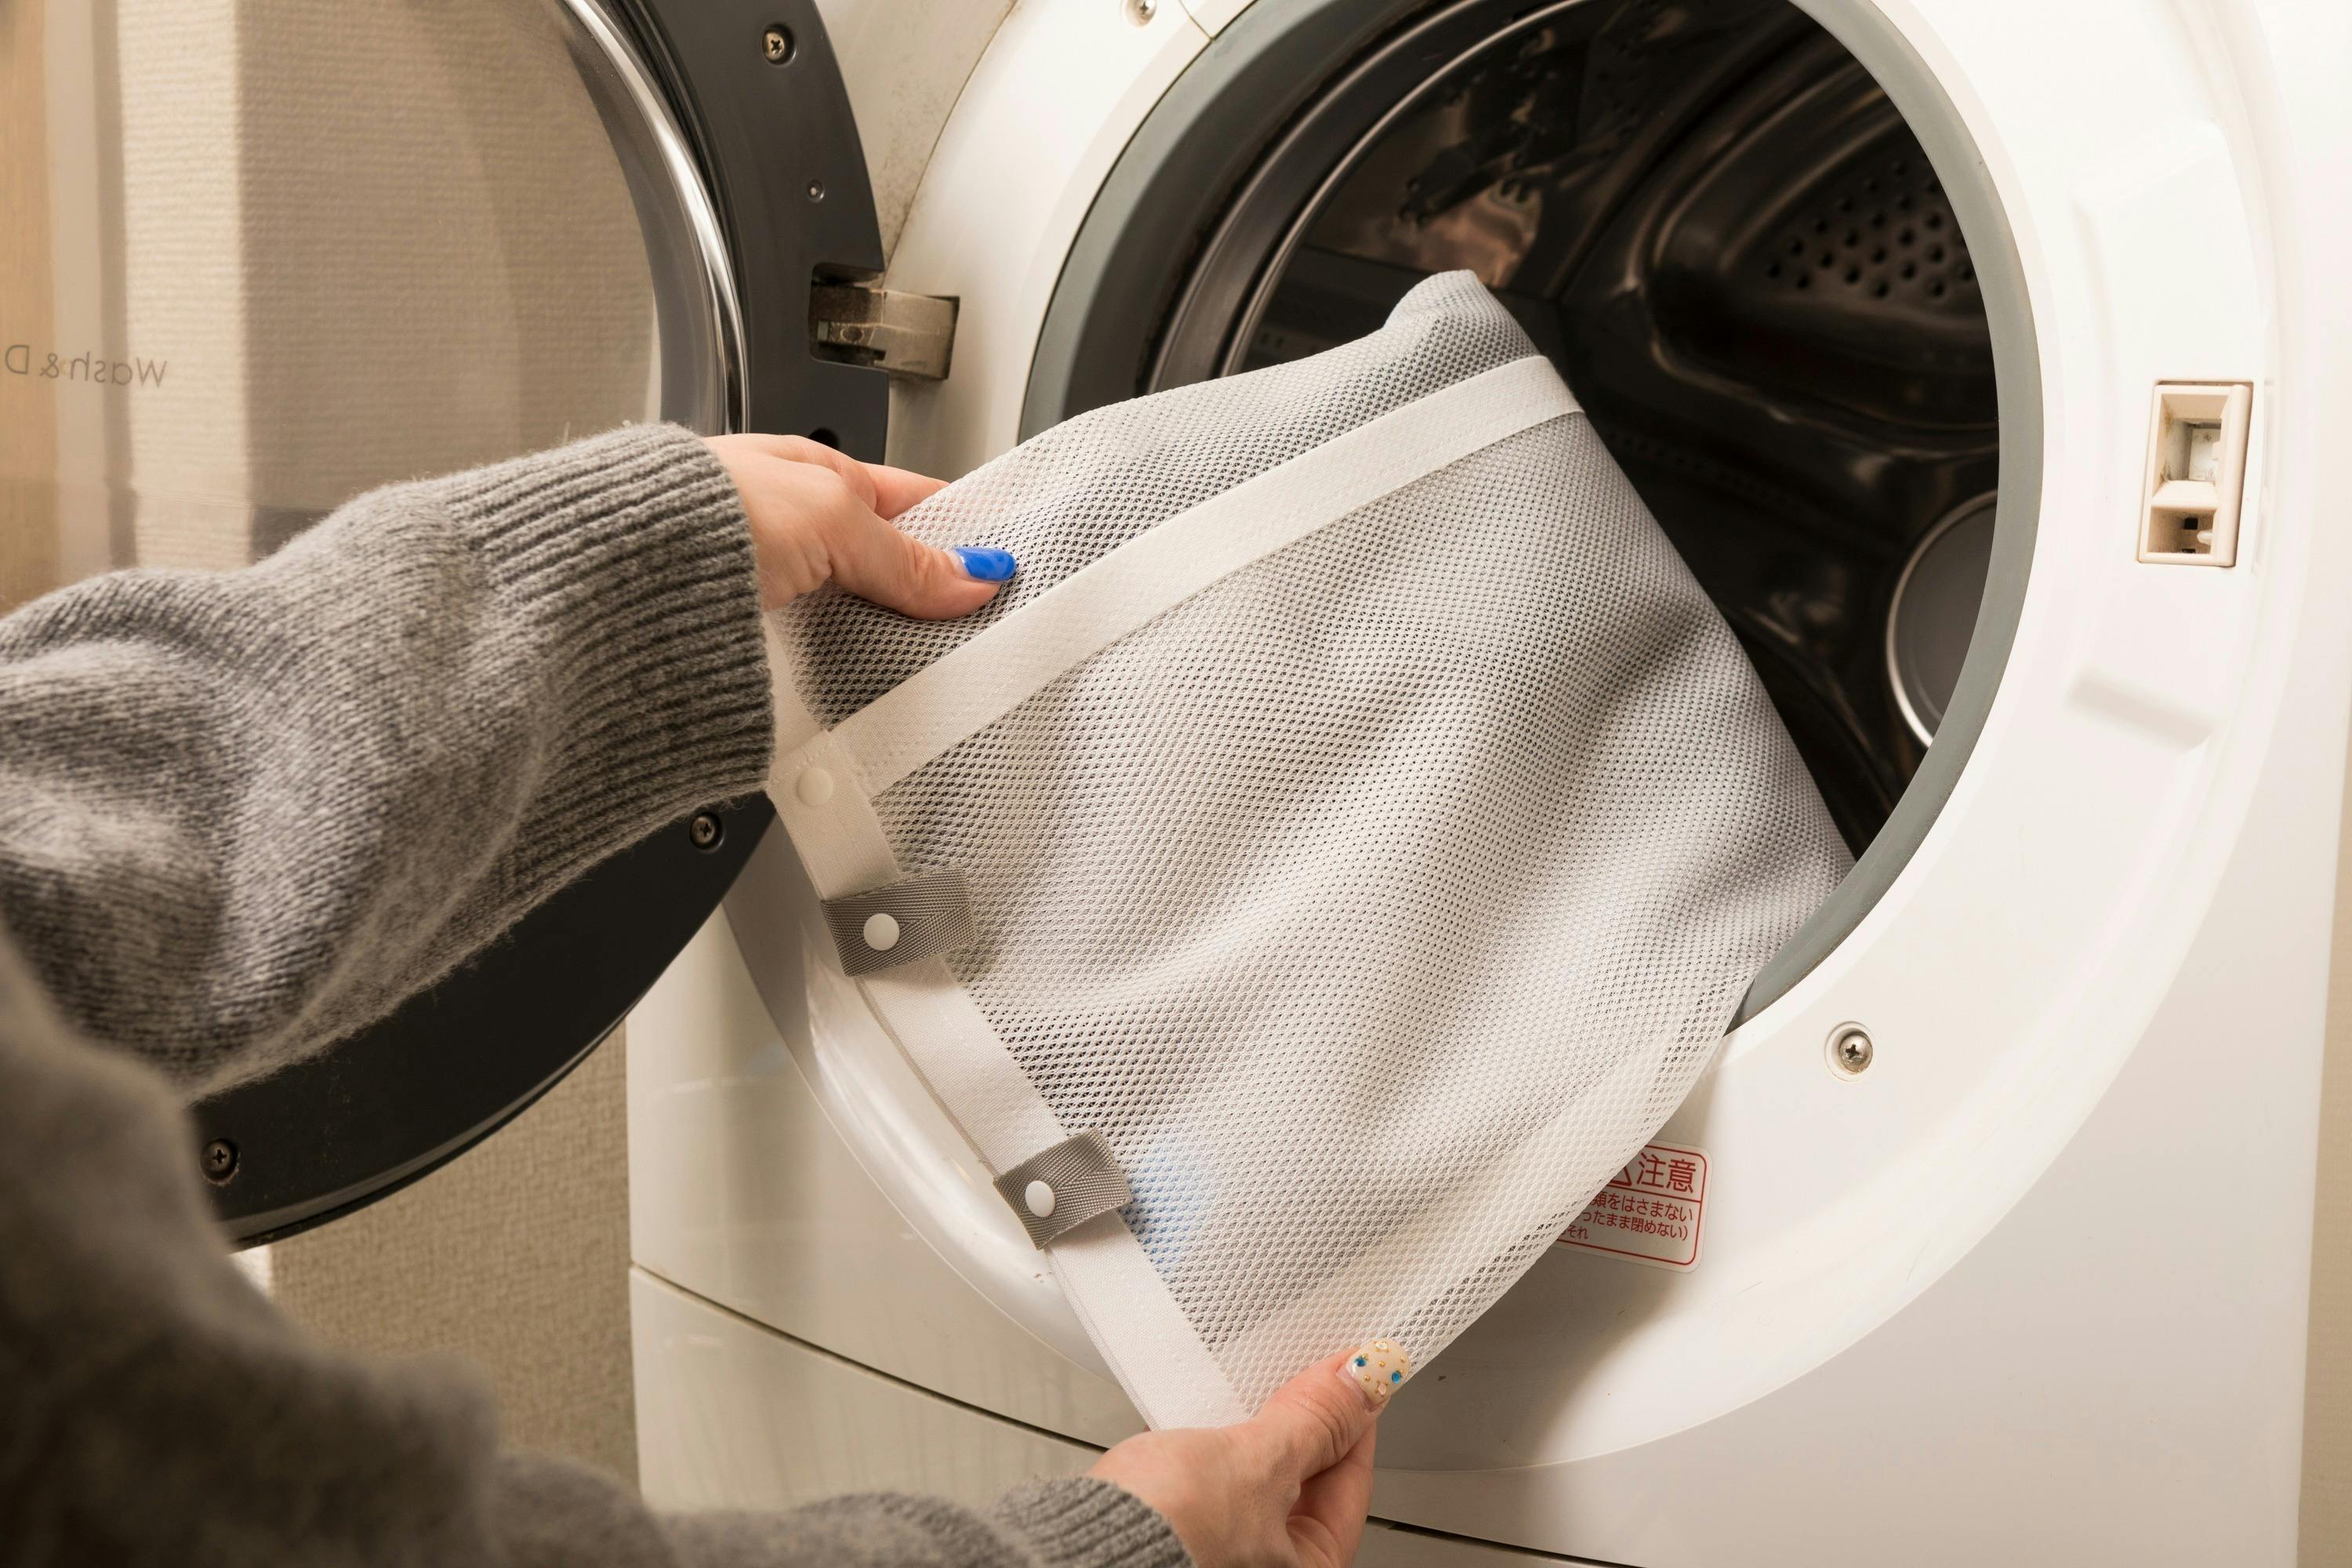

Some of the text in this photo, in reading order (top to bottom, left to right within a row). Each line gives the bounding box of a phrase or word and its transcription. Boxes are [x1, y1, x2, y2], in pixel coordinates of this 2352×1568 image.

[1636, 1152, 1697, 1193] 注意
[1589, 1191, 1693, 1222] 類をはさまない
[1576, 1210, 1688, 1241] ったまま閉めない）
